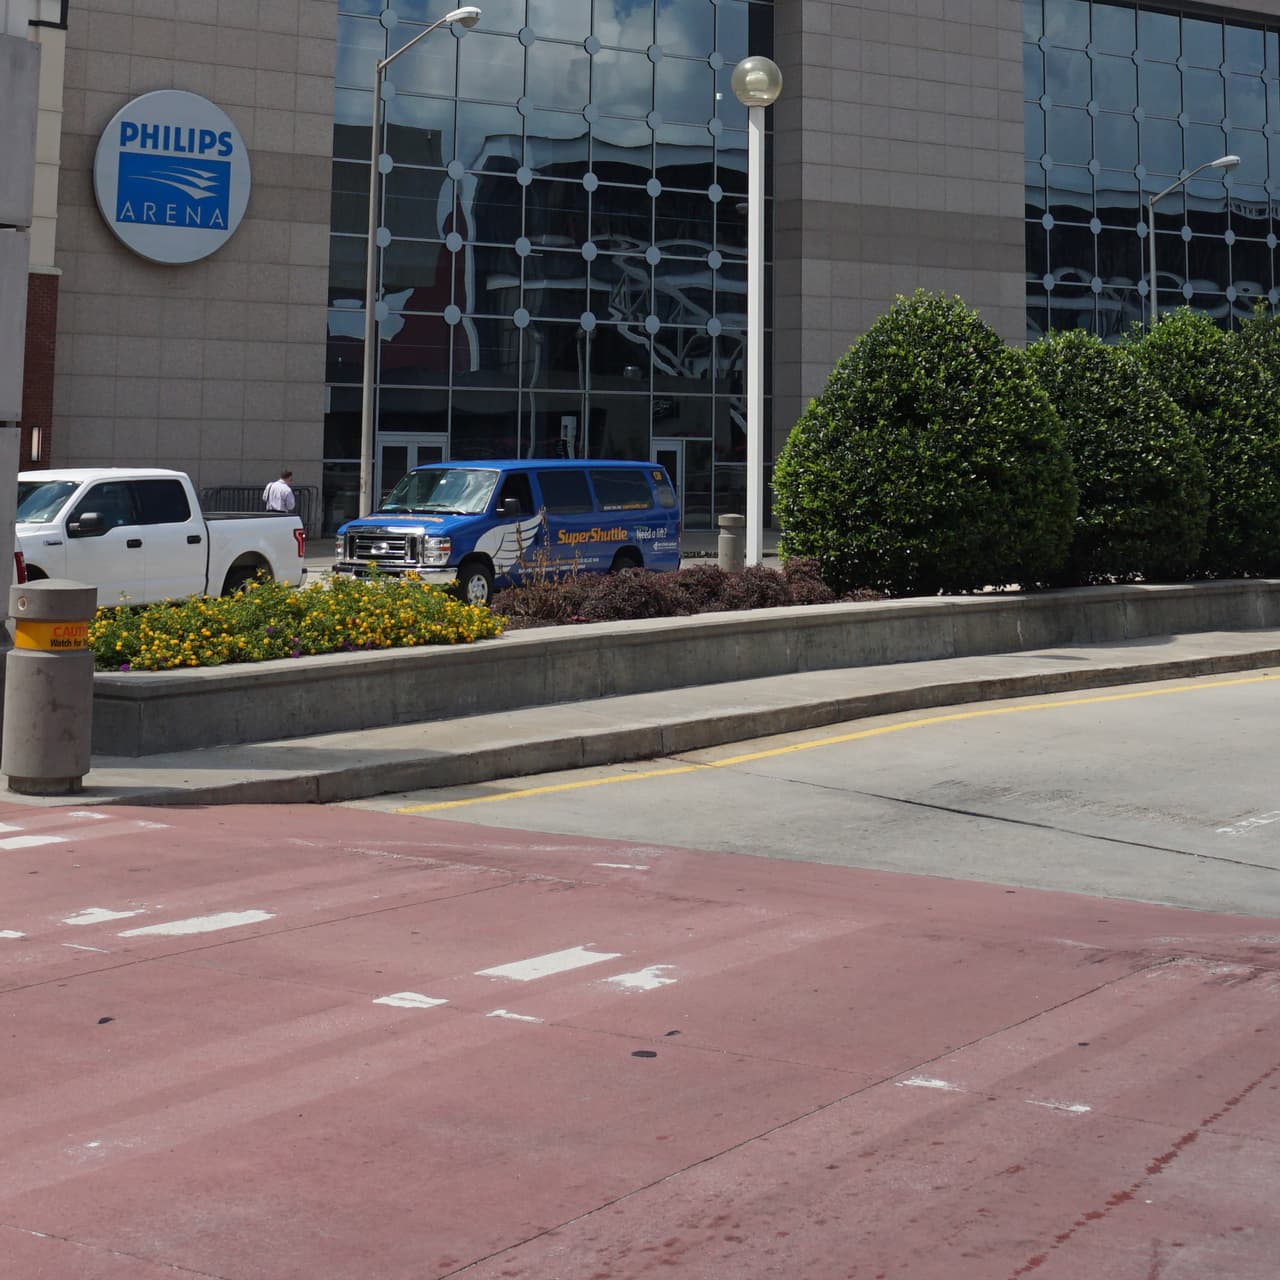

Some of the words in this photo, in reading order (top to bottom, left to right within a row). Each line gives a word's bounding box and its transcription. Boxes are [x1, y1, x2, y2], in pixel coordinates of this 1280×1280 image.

[120, 121, 233, 157] PHILIPS
[120, 200, 225, 227] ARENA
[557, 527, 628, 547] SuperShuttle
[50, 639, 72, 648] Watch
